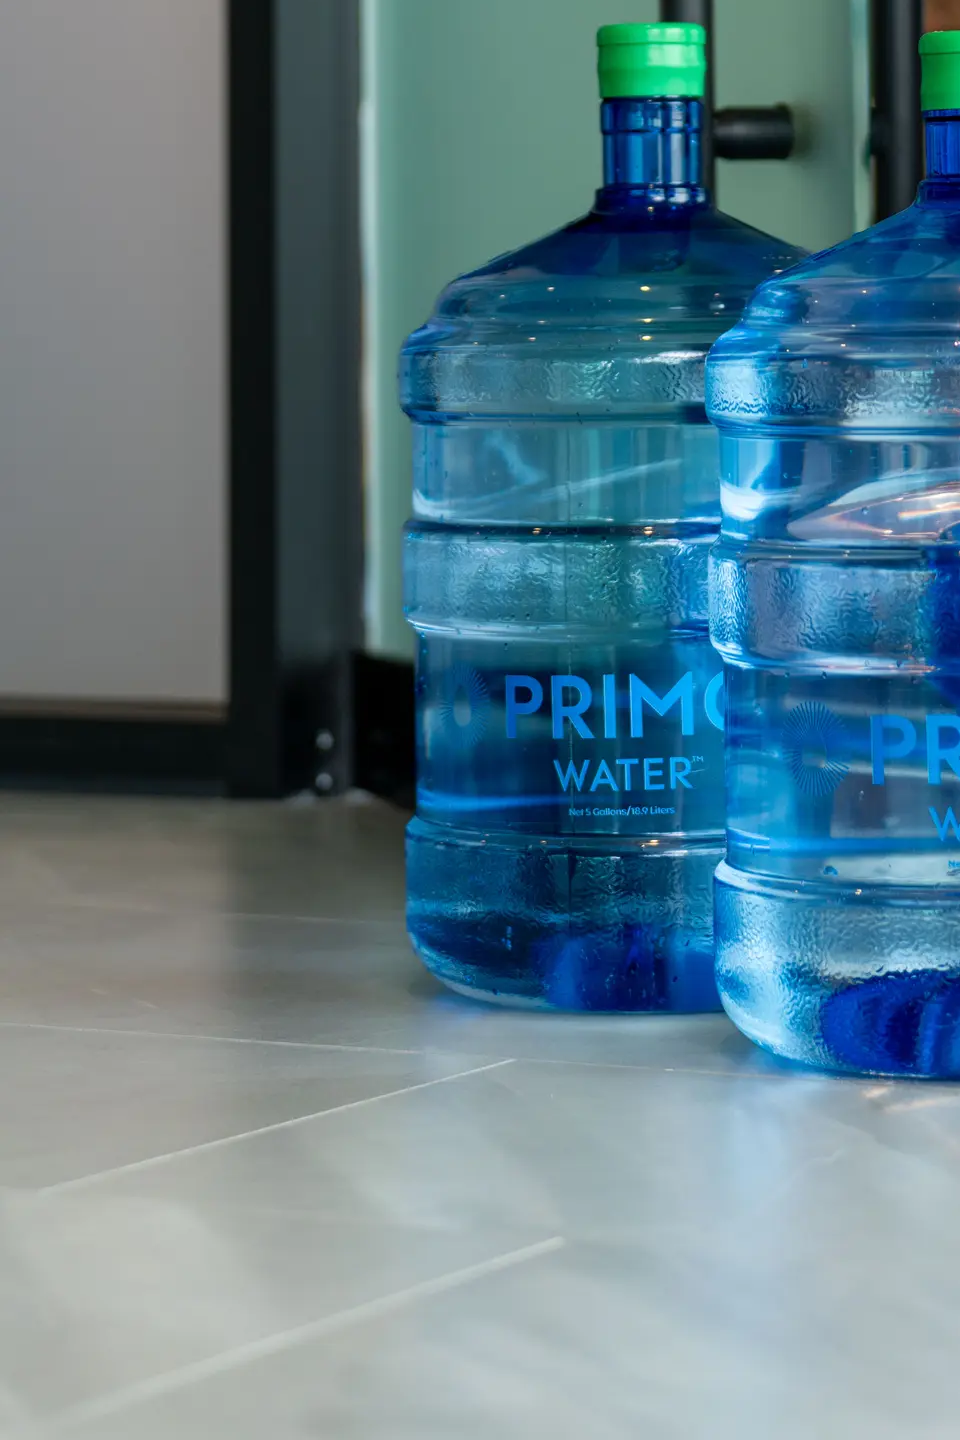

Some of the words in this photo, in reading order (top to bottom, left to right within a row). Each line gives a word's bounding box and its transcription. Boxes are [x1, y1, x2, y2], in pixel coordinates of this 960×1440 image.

[568, 807, 584, 816] Net
[585, 807, 592, 816] 5
[650, 805, 676, 815] Liters
